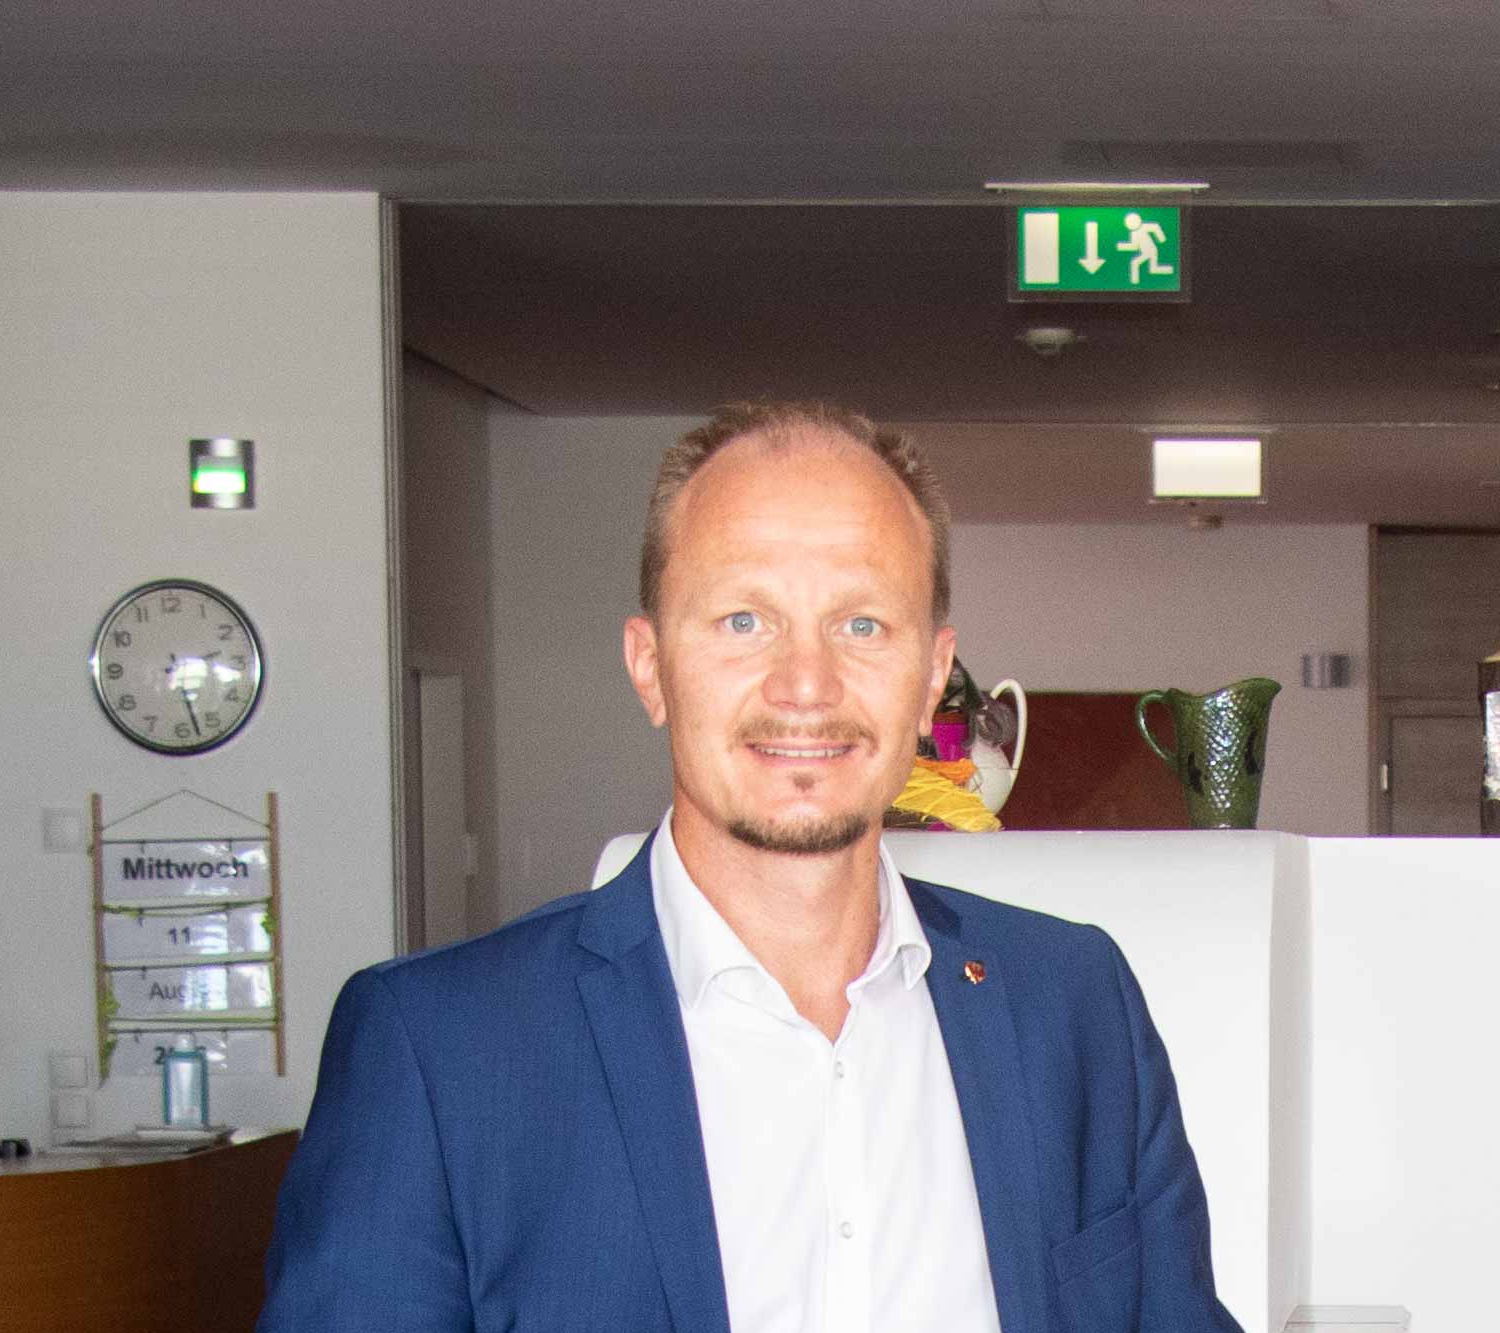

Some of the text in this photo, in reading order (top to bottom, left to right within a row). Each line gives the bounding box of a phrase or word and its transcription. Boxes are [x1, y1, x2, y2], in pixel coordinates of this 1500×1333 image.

[161, 597, 181, 613] 12
[200, 603, 207, 620] 1
[136, 606, 150, 623] 11
[113, 630, 132, 648] 10
[218, 624, 234, 641] 2
[106, 662, 124, 680] 9
[118, 694, 137, 711] 8
[226, 687, 239, 703] 4
[142, 714, 159, 733] 7
[205, 711, 222, 728] 5
[174, 721, 192, 739] 6
[122, 857, 249, 880] Mittwoch
[167, 926, 193, 945] 11
